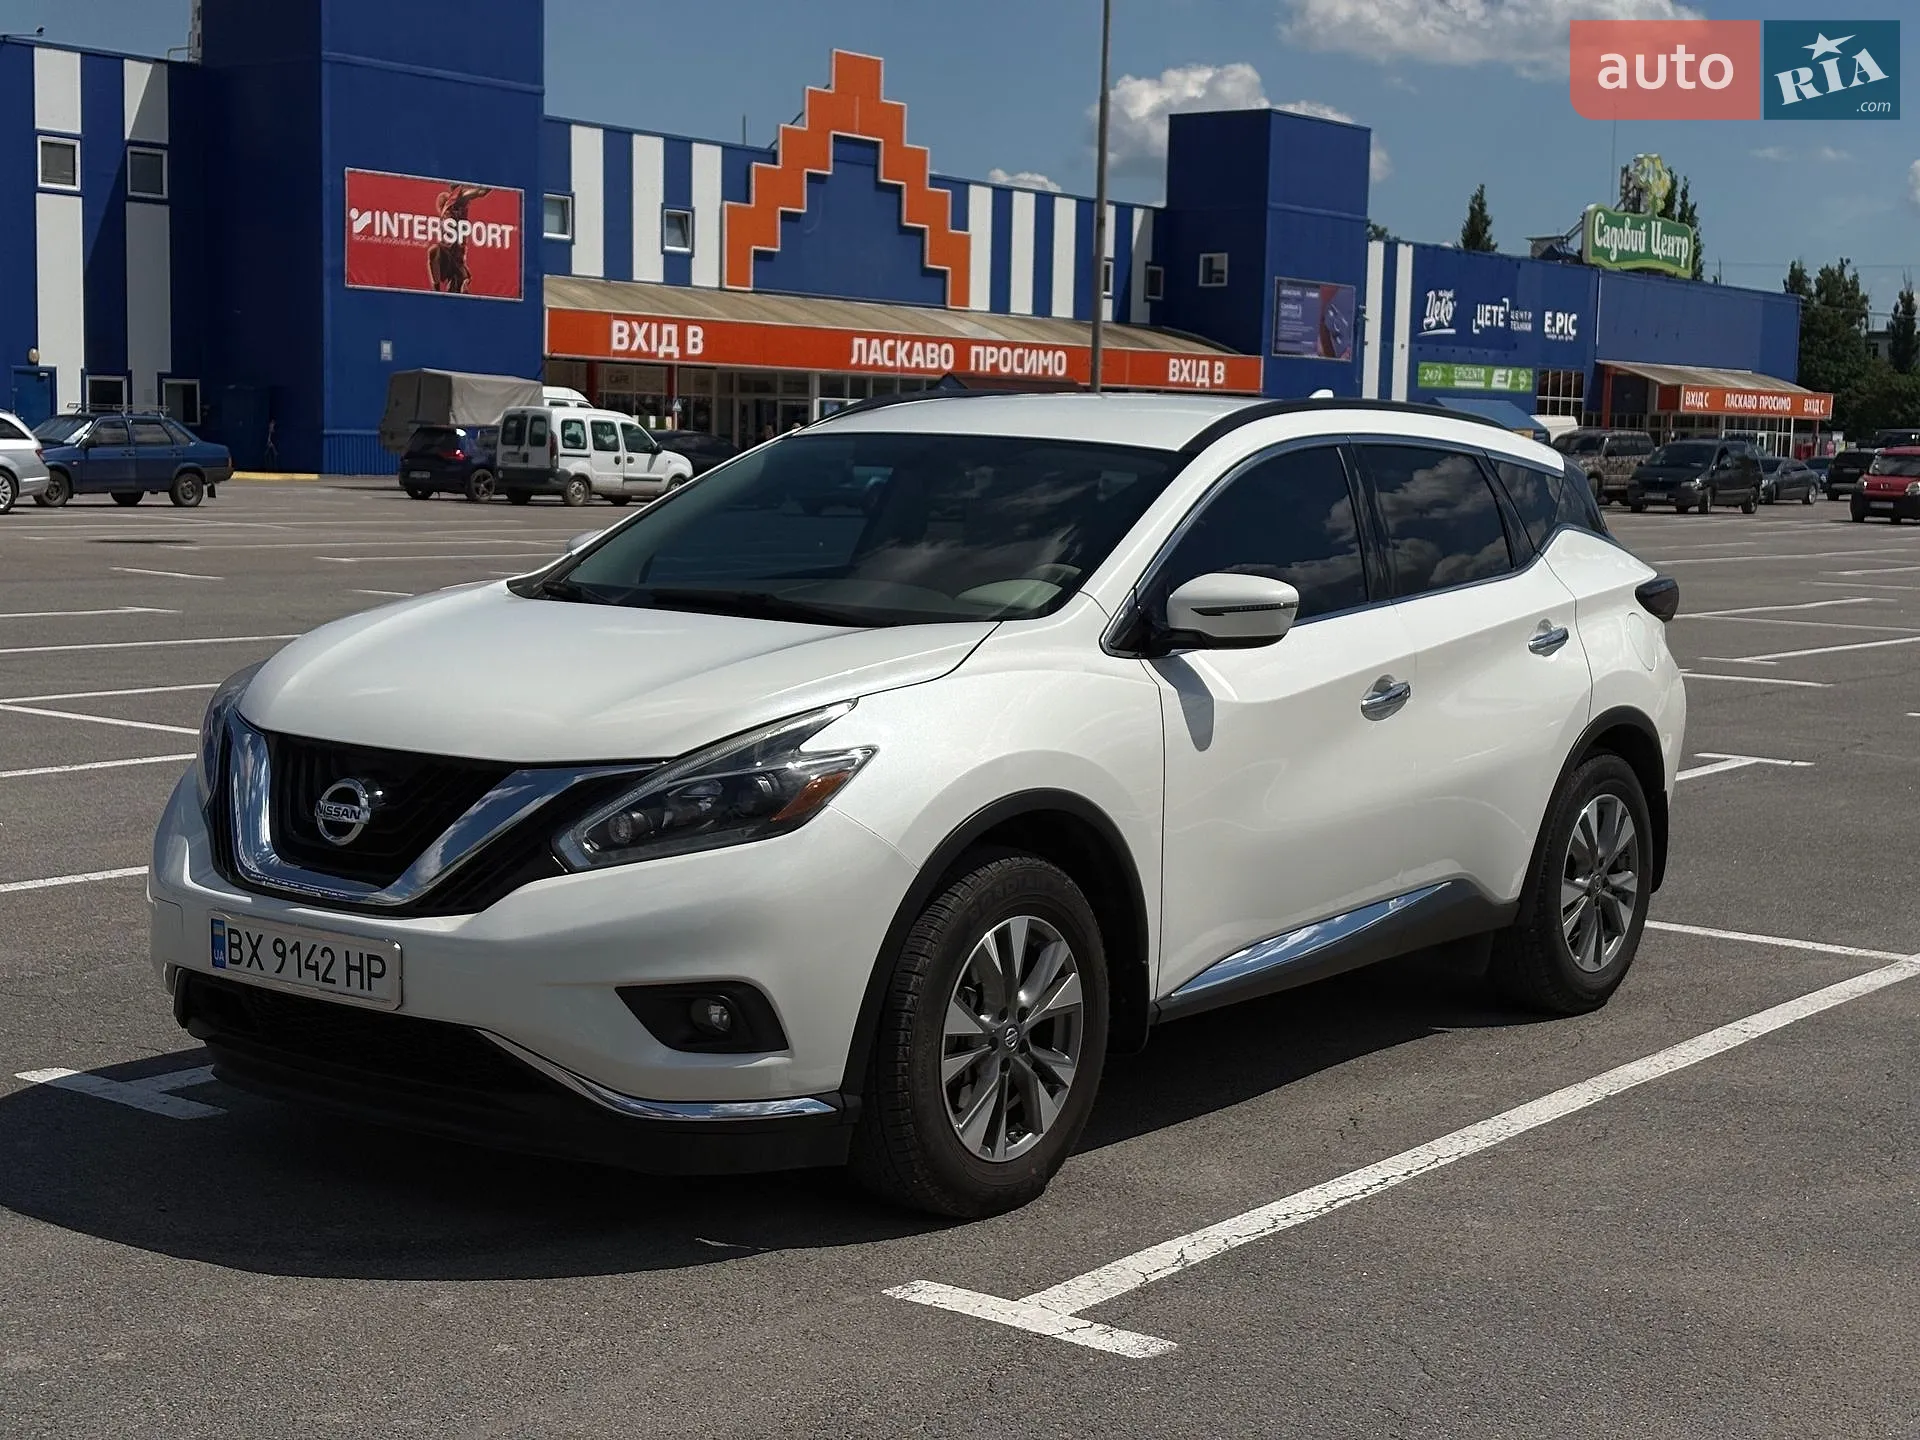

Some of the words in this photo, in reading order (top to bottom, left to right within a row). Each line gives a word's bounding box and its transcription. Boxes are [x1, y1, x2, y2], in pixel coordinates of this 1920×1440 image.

[374, 210, 515, 250] INTERSPORT
[1594, 211, 1646, 262] Садовий
[1650, 220, 1689, 268] Центр
[1544, 311, 1577, 337] E.PIC
[611, 319, 680, 359] ВХІД
[686, 325, 704, 355] В
[850, 337, 955, 370] ЛАСКАВО
[969, 345, 1068, 376] ПРОСИМО
[1168, 358, 1210, 388] ВХІД
[1213, 361, 1225, 384] В
[1685, 391, 1704, 408] ВХІД
[1704, 392, 1710, 408] С
[1725, 393, 1757, 410] ЛАСКАВО
[1759, 395, 1791, 411] ПРОСИМО
[1804, 398, 1820, 414] ВХІД
[316, 801, 361, 820] NISSAN
[214, 949, 225, 961] UA
[227, 927, 265, 971] BX
[272, 938, 337, 985] 9142
[345, 950, 387, 991] HP
